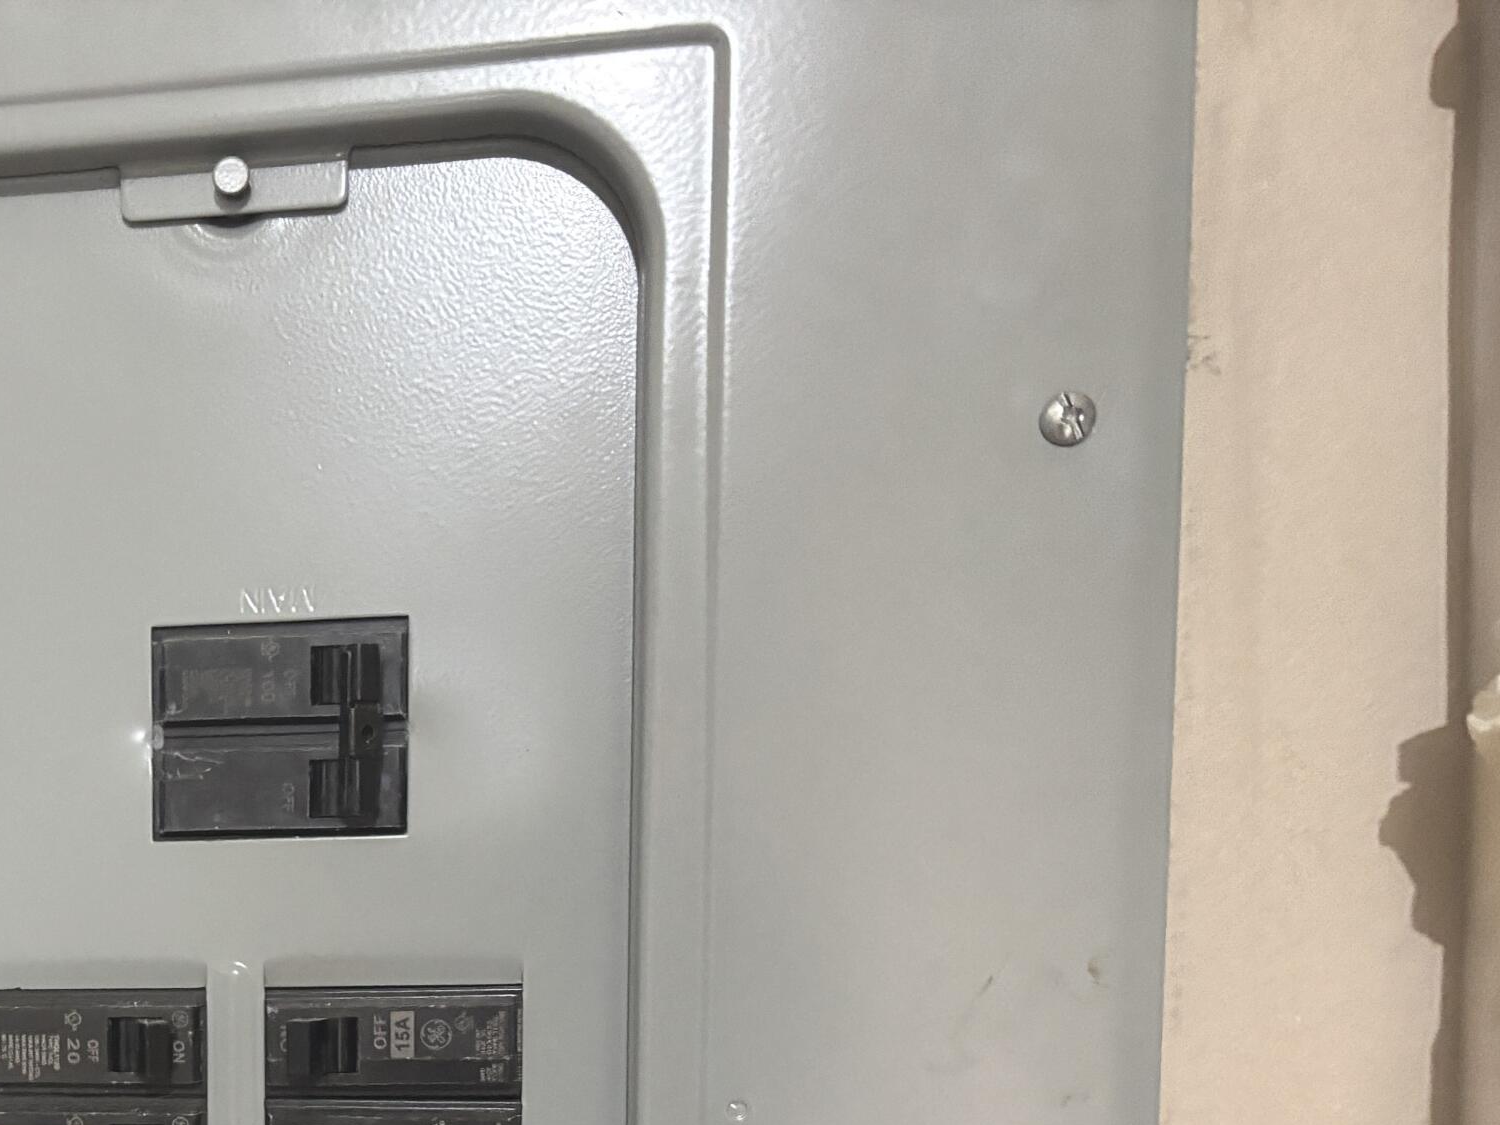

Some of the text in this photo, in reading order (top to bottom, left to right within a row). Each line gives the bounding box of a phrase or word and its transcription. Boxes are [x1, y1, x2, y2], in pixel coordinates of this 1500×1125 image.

[374, 1015, 387, 1049] OFF
[395, 1017, 410, 1052] 15A
[67, 1038, 80, 1064] 20
[87, 1038, 100, 1063] OFF
[173, 1041, 186, 1064] ON
